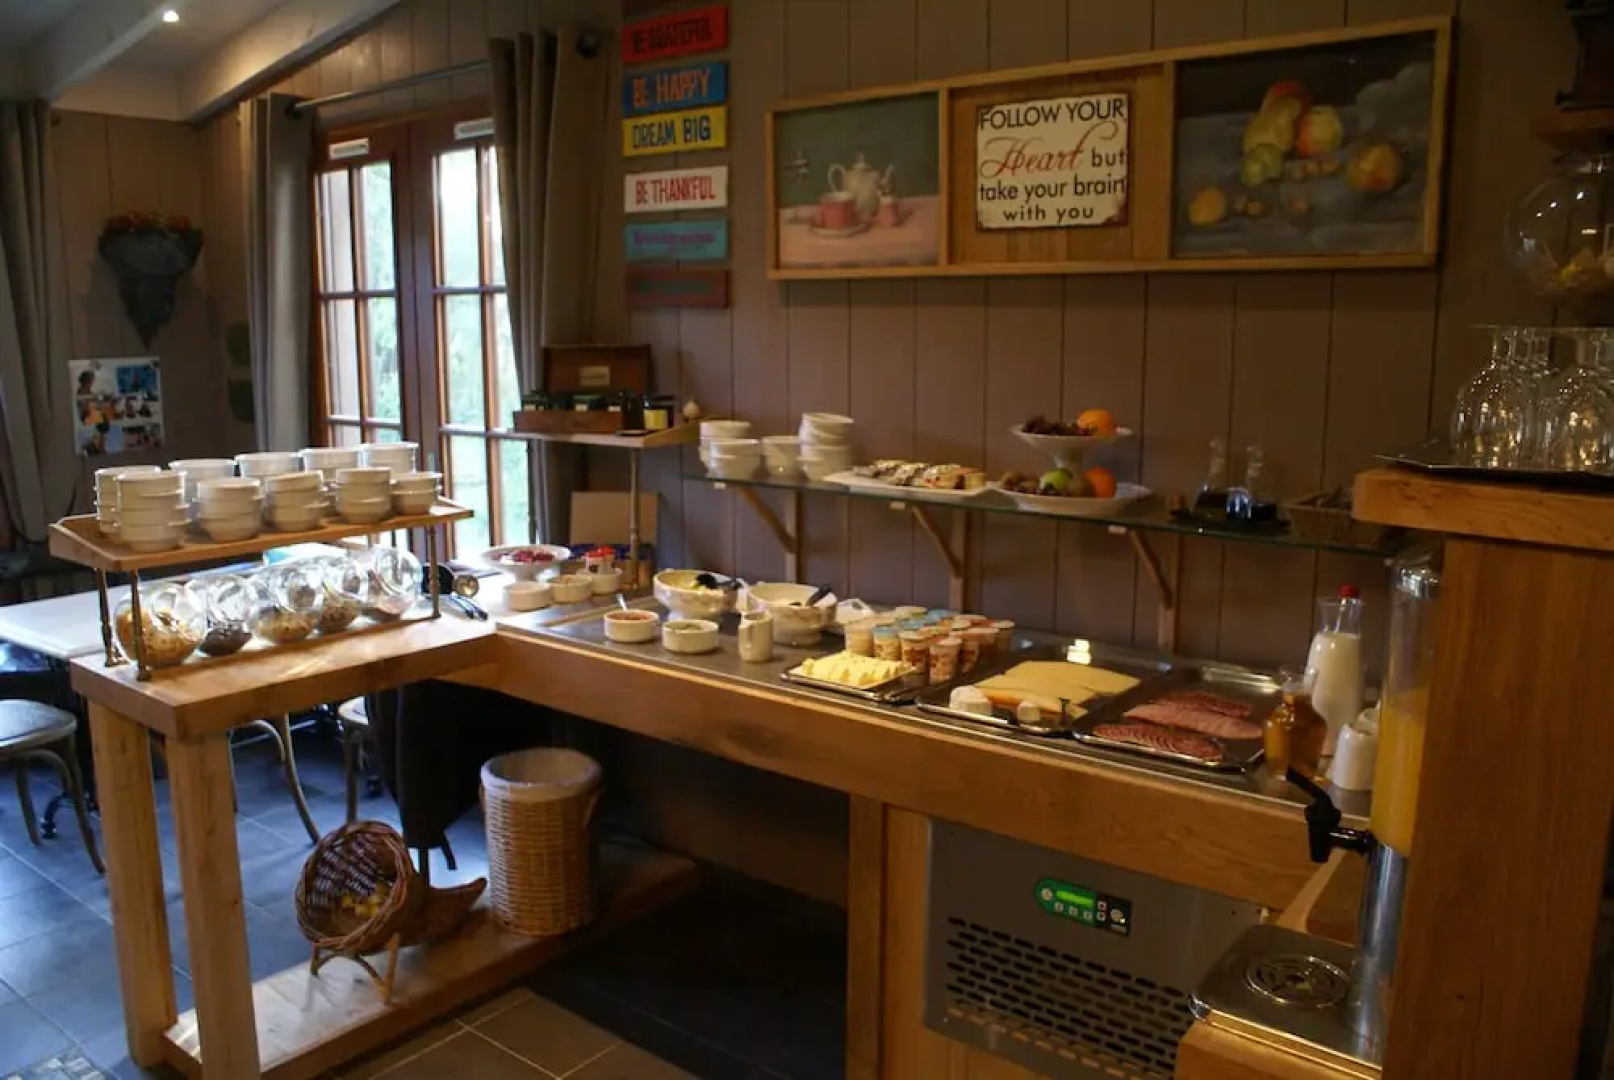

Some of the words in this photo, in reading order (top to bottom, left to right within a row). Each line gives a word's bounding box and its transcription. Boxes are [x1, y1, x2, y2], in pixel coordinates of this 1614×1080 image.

[656, 67, 711, 105] HAPPY
[980, 104, 1062, 130] FOLLOW
[1066, 98, 1125, 122] YOUR
[632, 120, 677, 150] DREAM
[683, 114, 711, 144] BIG
[980, 121, 1118, 179] Heart
[1091, 147, 1126, 167] but
[635, 179, 648, 206] BE
[650, 175, 716, 205] THANKFUL
[980, 181, 1019, 201] take
[1024, 181, 1068, 204] your
[1073, 173, 1126, 196] brain
[1003, 205, 1046, 221] with
[1056, 207, 1094, 224] you
